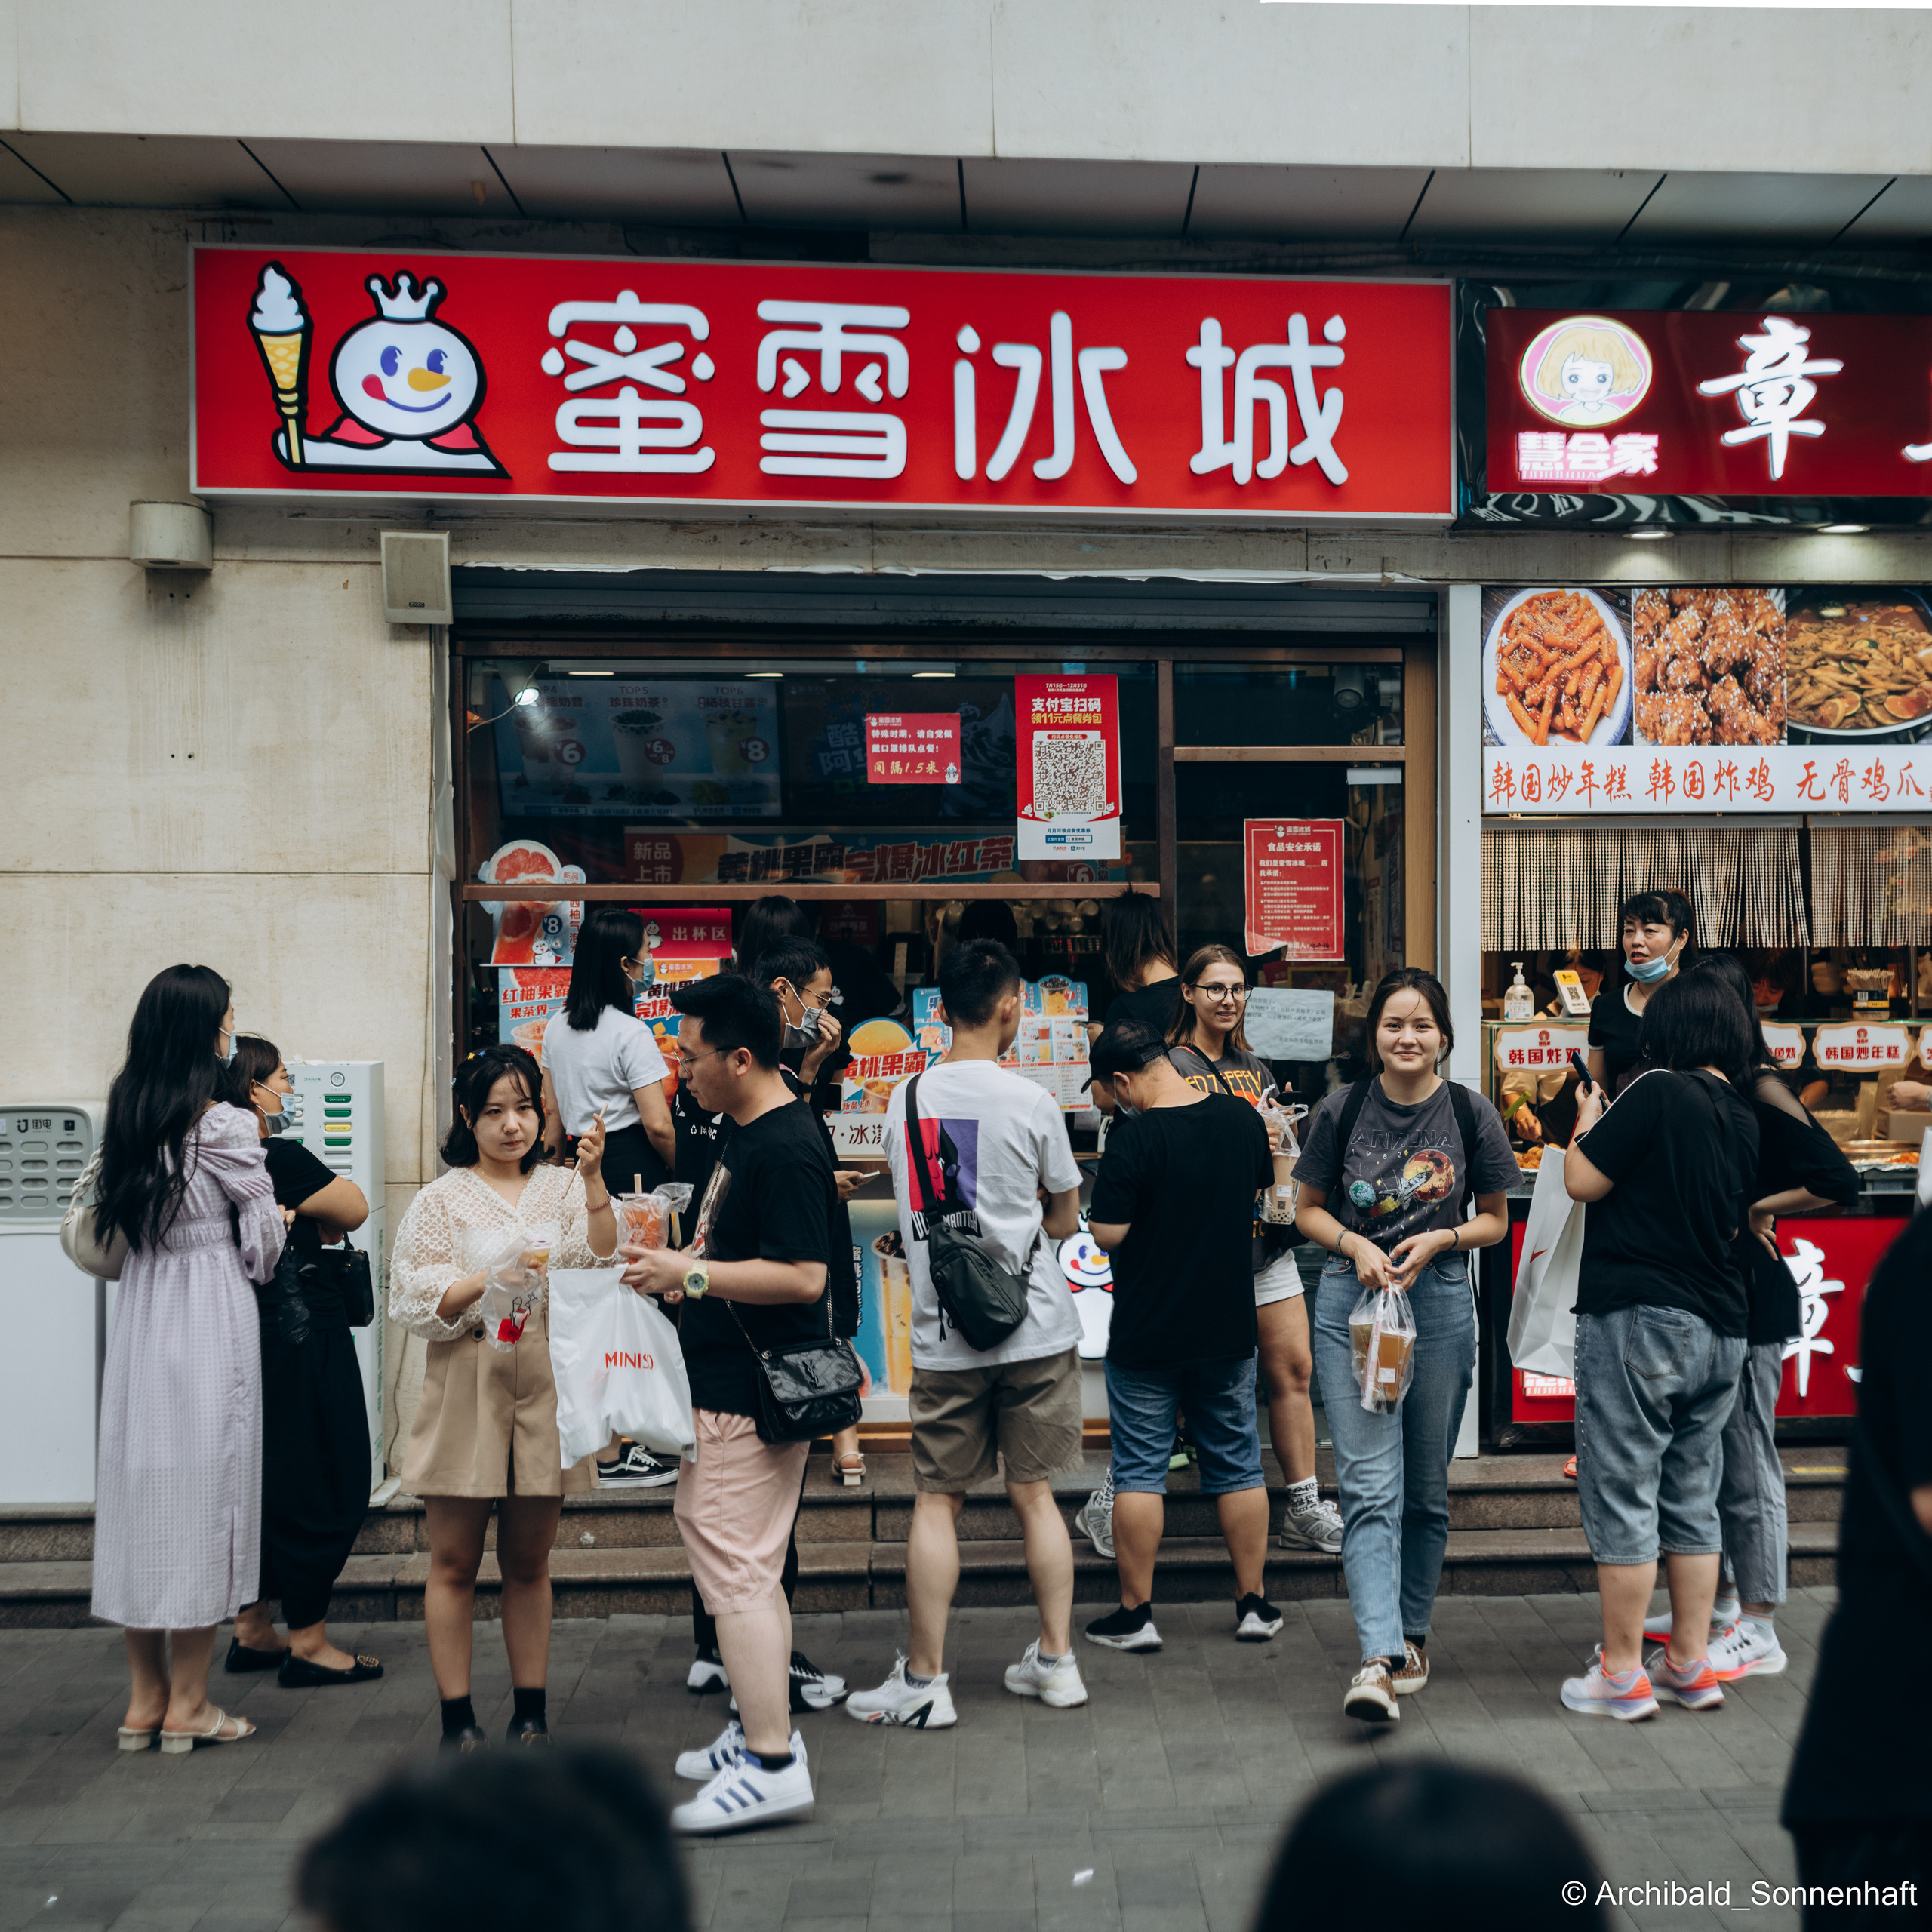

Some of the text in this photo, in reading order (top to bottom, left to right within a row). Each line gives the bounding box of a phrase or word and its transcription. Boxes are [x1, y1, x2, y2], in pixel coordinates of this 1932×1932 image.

[540, 290, 1349, 485] 蜜雪冰城
[1697, 316, 1932, 481] 章
[609, 697, 660, 708] 珍珠奶茶
[1032, 697, 1102, 712] 支付宝扫码
[1031, 712, 1102, 724] 领11元点餐券包
[871, 729, 953, 739] 特殊时期，请自觉佩
[874, 760, 940, 776] 间隔1.5米
[1488, 757, 1925, 808] 韩国炒年糕 韩国炸鸡 无骨鸡爪
[633, 841, 672, 860] 新品
[1267, 842, 1321, 852] 食品安全承诺
[563, 872, 580, 881] 新品
[634, 864, 672, 884] 上市
[543, 917, 558, 934] ¥8
[672, 925, 727, 942] 出杯区
[509, 1000, 567, 1020] 果茶界一
[1769, 1047, 1796, 1060] 鱼烧
[1824, 1045, 1900, 1060] 韩国炒年糕
[842, 1099, 871, 1110] 新品上市
[32, 1119, 51, 1129] 街电
[1350, 1127, 1455, 1150] ARIZONA
